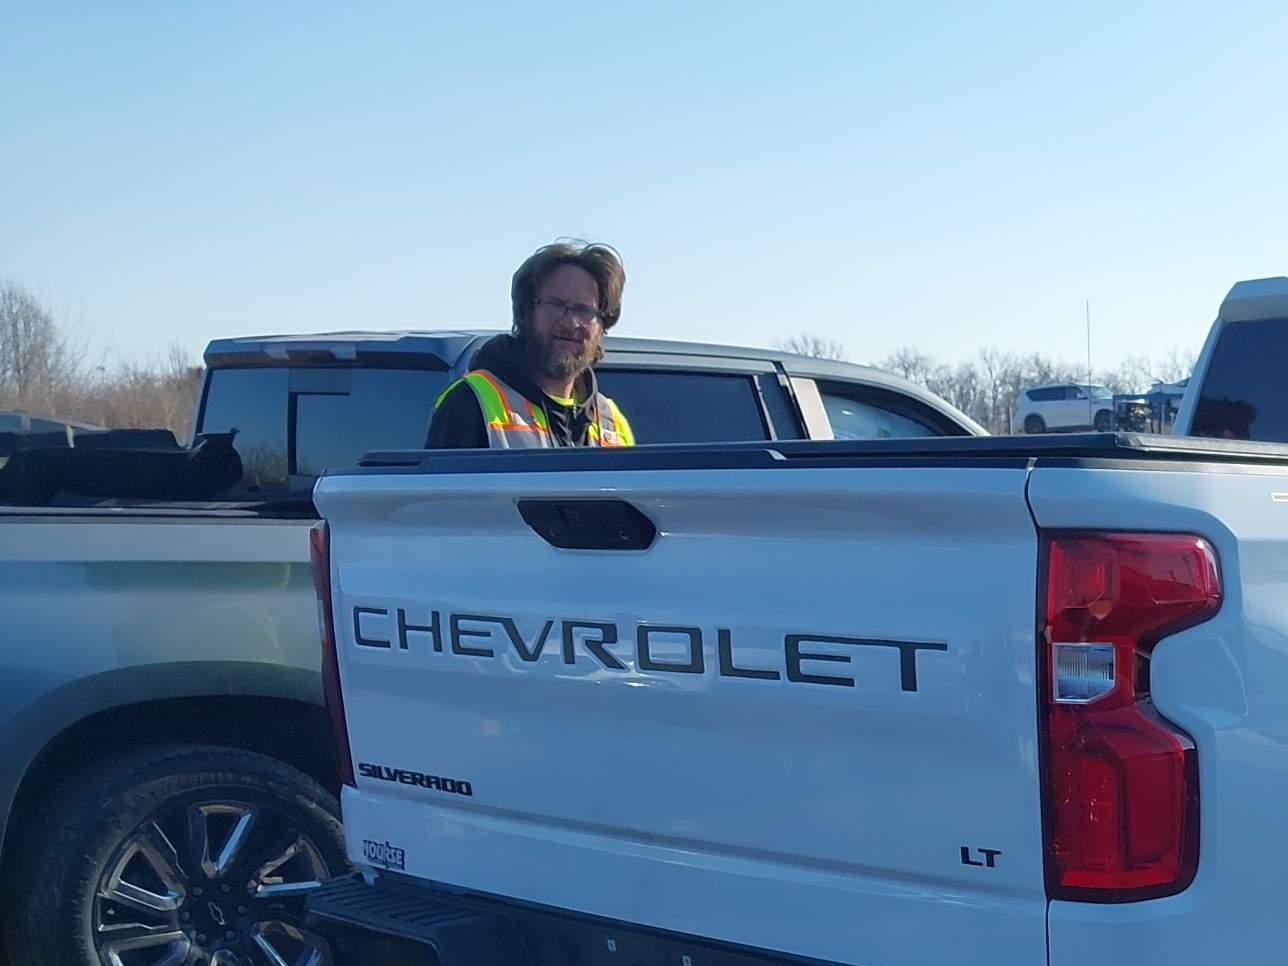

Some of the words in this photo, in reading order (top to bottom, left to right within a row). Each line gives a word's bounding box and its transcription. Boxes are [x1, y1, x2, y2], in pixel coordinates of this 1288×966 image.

[353, 606, 948, 692] CHEVROLET
[358, 762, 473, 796] SILVERADO
[960, 846, 1002, 868] LT
